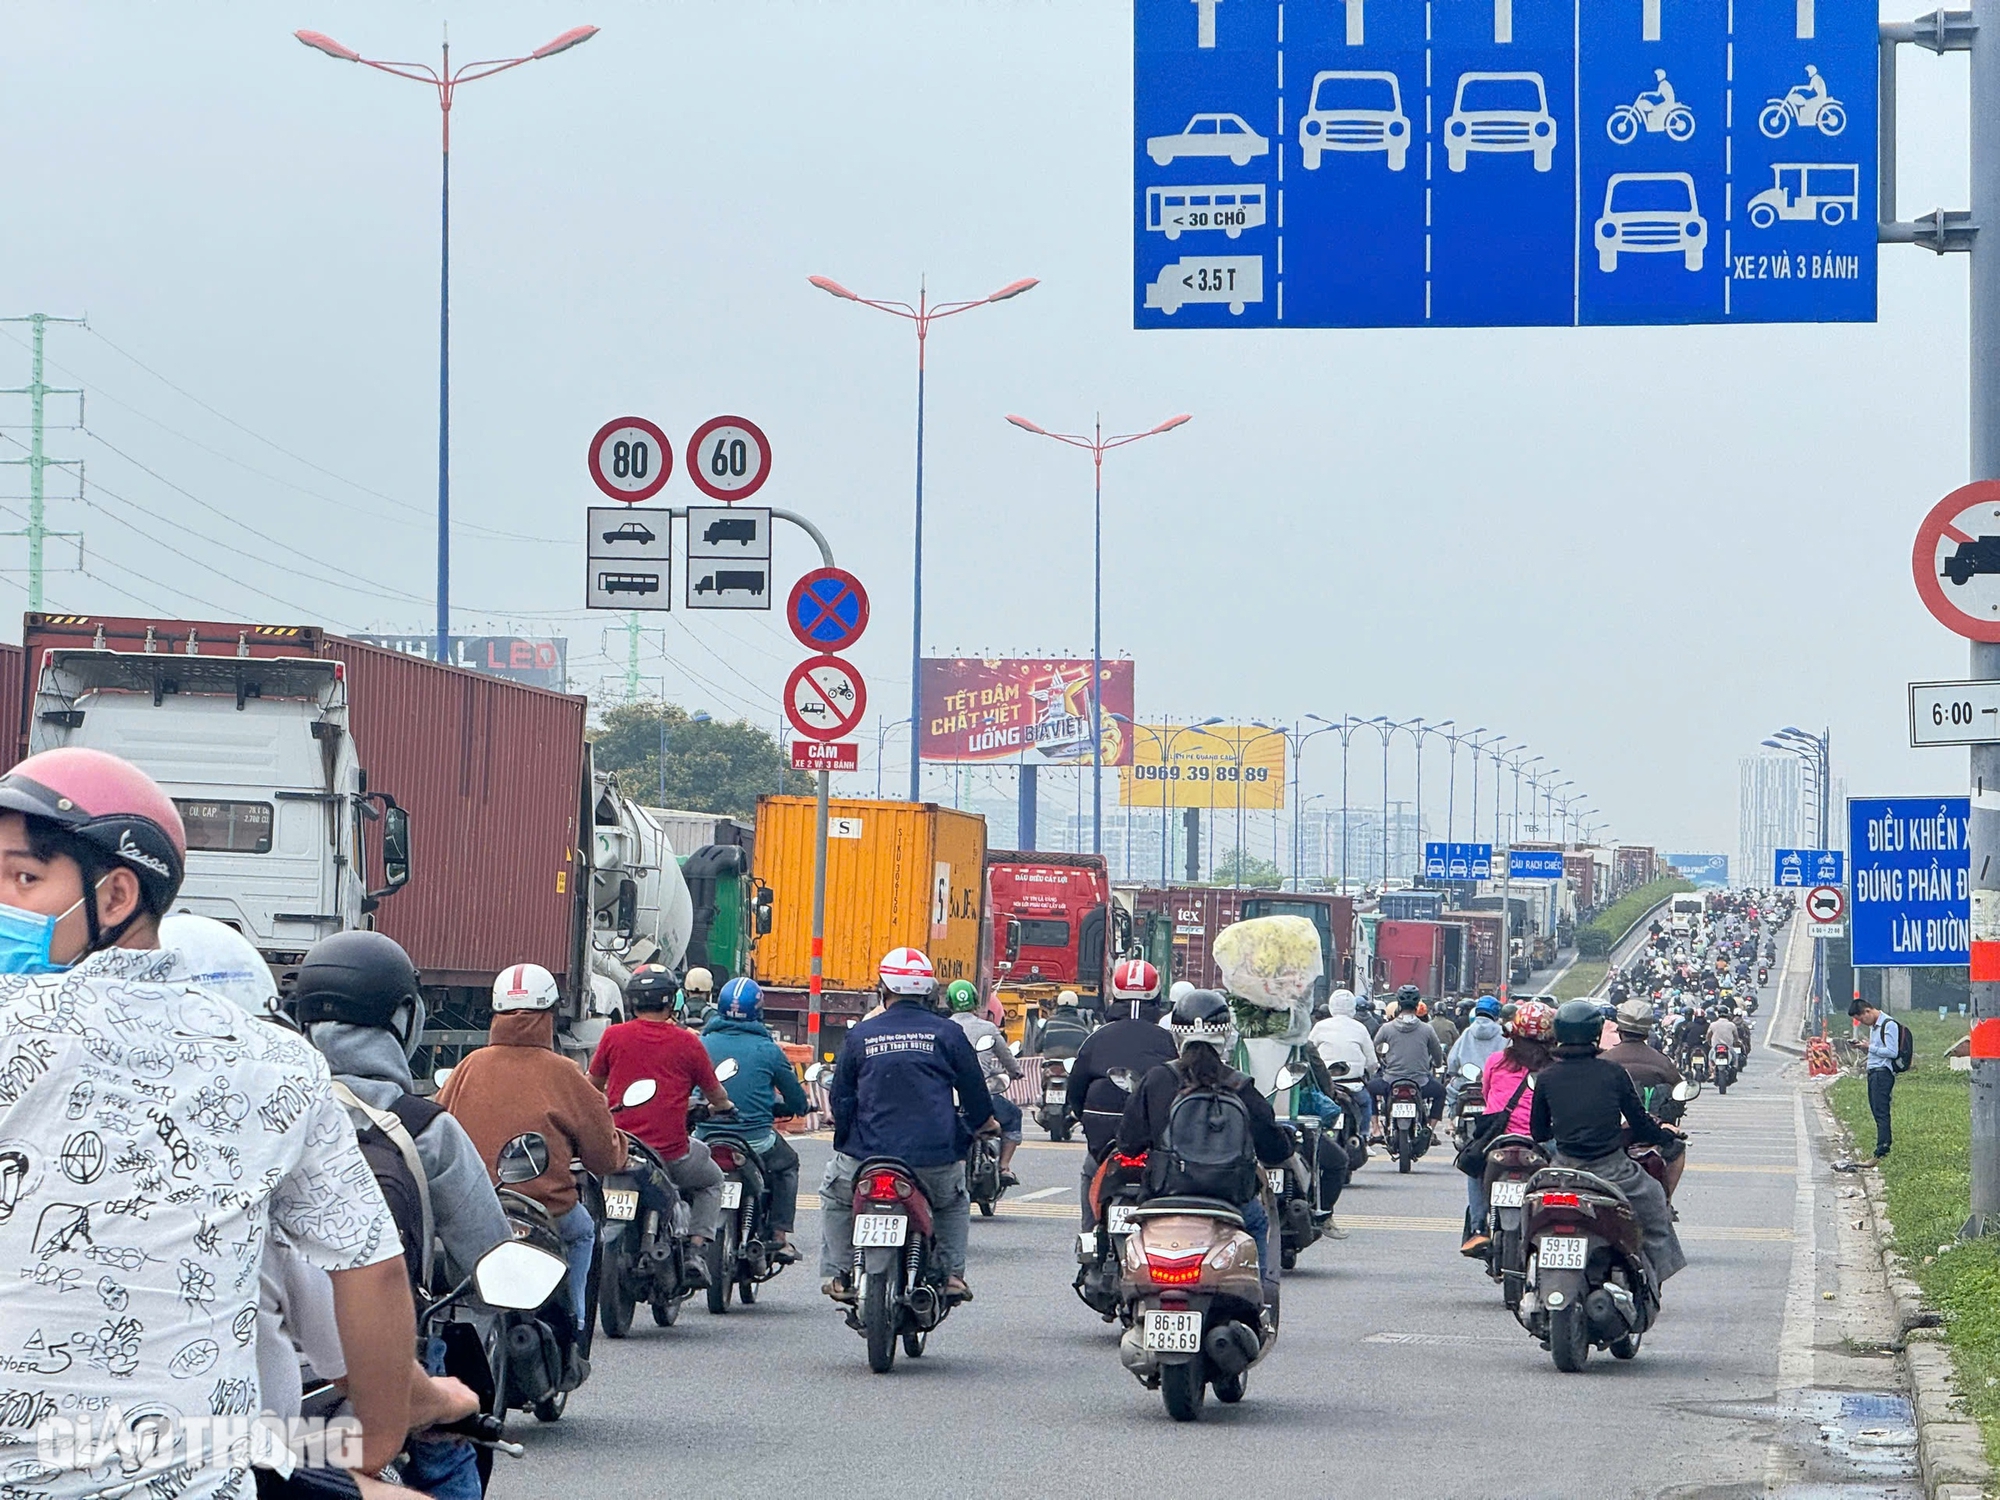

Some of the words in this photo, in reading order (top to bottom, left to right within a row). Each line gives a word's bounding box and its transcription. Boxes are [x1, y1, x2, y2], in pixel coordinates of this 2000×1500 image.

[1189, 212, 1209, 227] 30
[1733, 255, 1756, 280] XE
[1758, 255, 1769, 279] 2
[1771, 249, 1792, 279] VÀ
[1796, 254, 1807, 279] 3
[1811, 249, 1859, 279] BÁNH
[1198, 268, 1223, 292] 3.5
[1227, 268, 1237, 292] T
[613, 440, 648, 479] 80
[711, 439, 747, 477] 60
[487, 640, 560, 669] LED
[943, 687, 979, 712] TẾT
[931, 709, 980, 736] CHẤT
[982, 702, 1022, 727] VIỆT
[1931, 701, 1973, 726] 6:00
[968, 724, 1020, 752] UỐNG
[808, 742, 838, 759] CẤM
[795, 759, 805, 768] XE
[807, 760, 812, 768] 2
[814, 758, 824, 768] VÀ
[826, 761, 831, 769] 3
[833, 759, 855, 770] BÁNH
[1134, 764, 1269, 782] 0969.3989.89
[839, 820, 851, 835] S
[1867, 807, 1904, 852] ĐIỀU
[1909, 804, 1958, 851] KHIỂN
[1511, 855, 1524, 869] CẦU
[1525, 859, 1542, 871] RẠCH
[1544, 856, 1562, 870] CHIẾC
[1857, 862, 1902, 902] ĐÚNG
[1907, 857, 1951, 902] PHẦN
[1177, 907, 1200, 922] tex
[1892, 912, 1922, 952] LÀN
[1926, 911, 1970, 952] ĐƯỜN
[1494, 1194, 1523, 1205] 224.7
[863, 1218, 899, 1231] 61-L8
[861, 1231, 898, 1245] 7410
[1546, 1239, 1581, 1251] 59-V3
[1541, 1253, 1583, 1267] 503.56
[1147, 1333, 1198, 1351] 285.69
